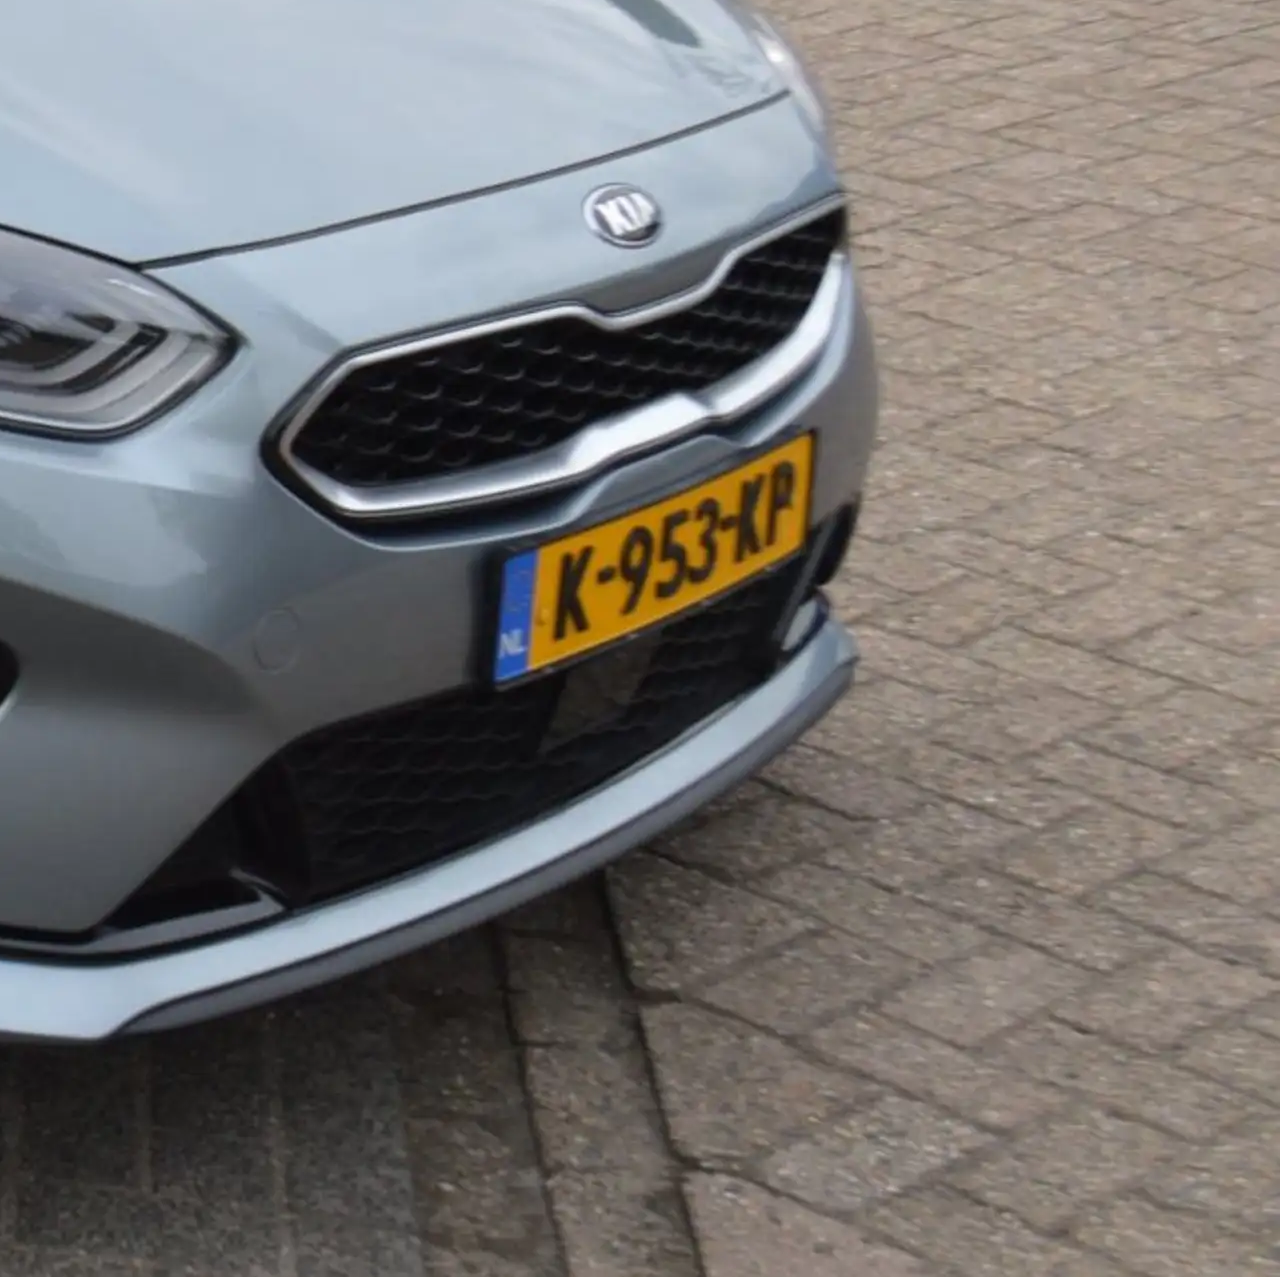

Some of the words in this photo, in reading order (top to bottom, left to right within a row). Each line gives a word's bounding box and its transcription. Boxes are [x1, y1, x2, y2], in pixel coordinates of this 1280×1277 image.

[595, 193, 654, 235] KIA
[552, 460, 796, 642] K-953-KP
[499, 629, 527, 659] NL
